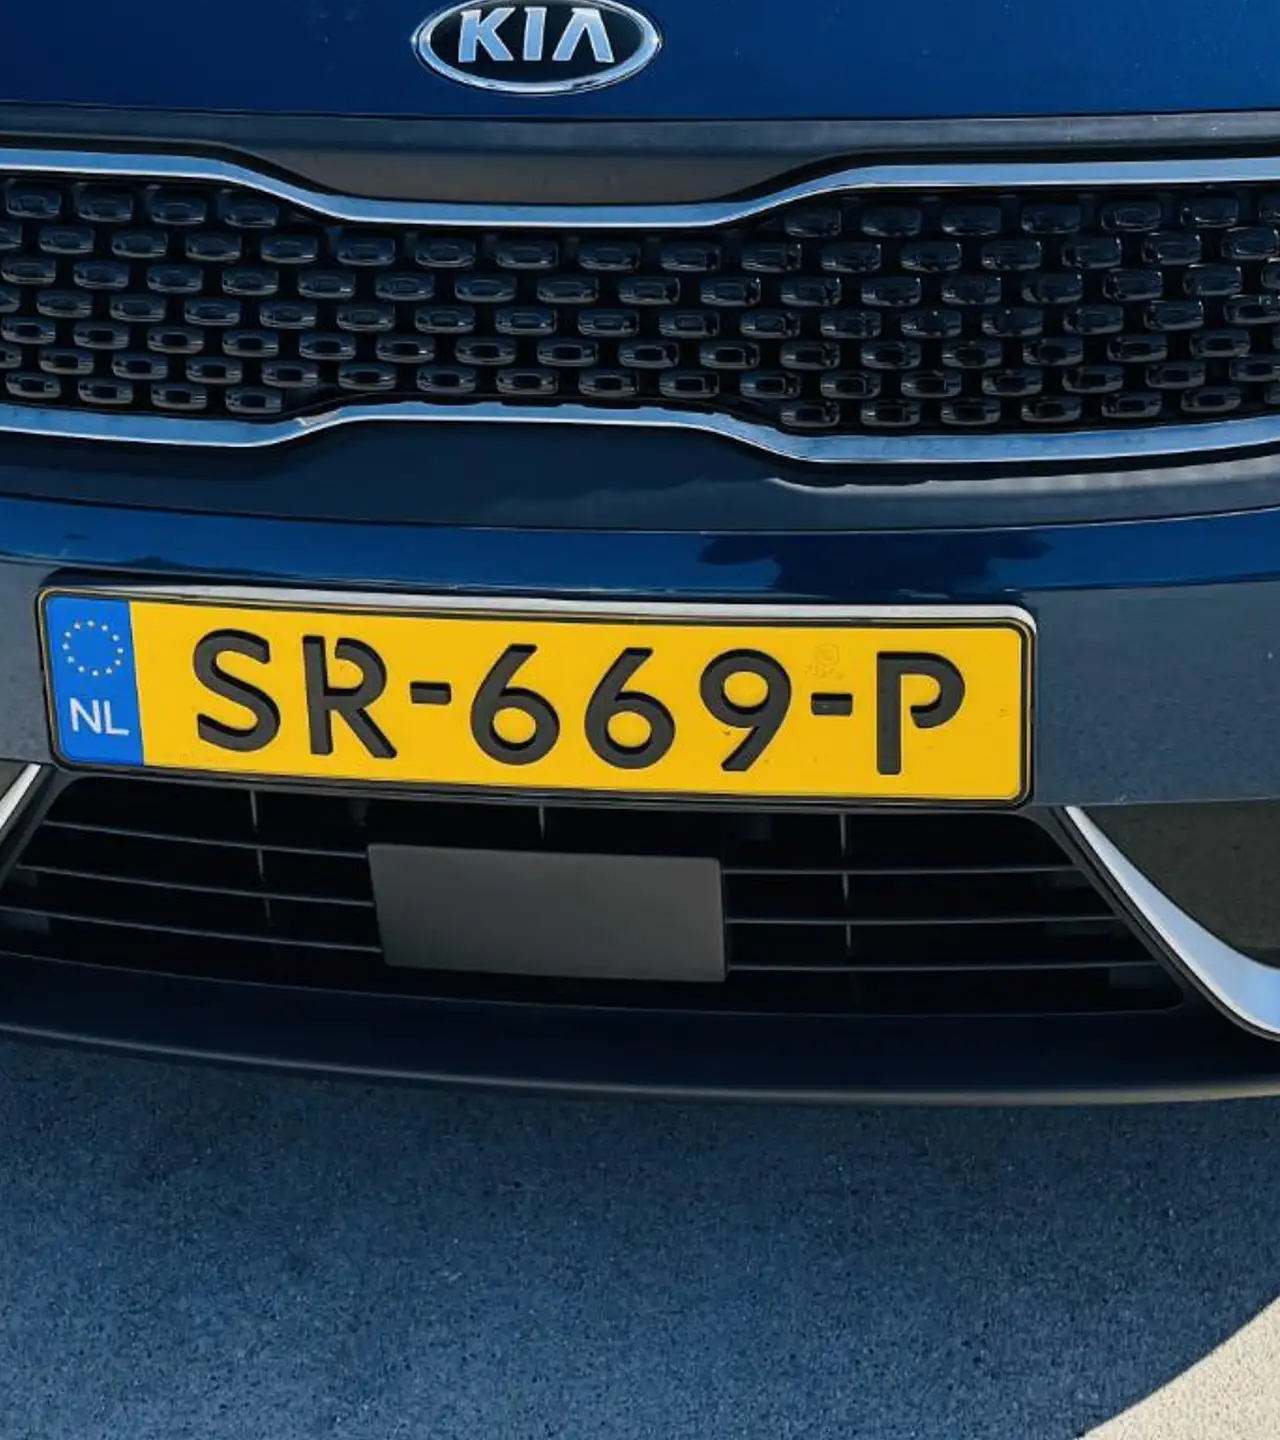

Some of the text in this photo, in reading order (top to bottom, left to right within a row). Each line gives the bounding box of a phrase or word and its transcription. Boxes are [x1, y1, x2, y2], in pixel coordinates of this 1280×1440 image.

[458, 6, 615, 63] KIA
[70, 698, 130, 736] NL
[193, 628, 966, 776] SR-669-P
